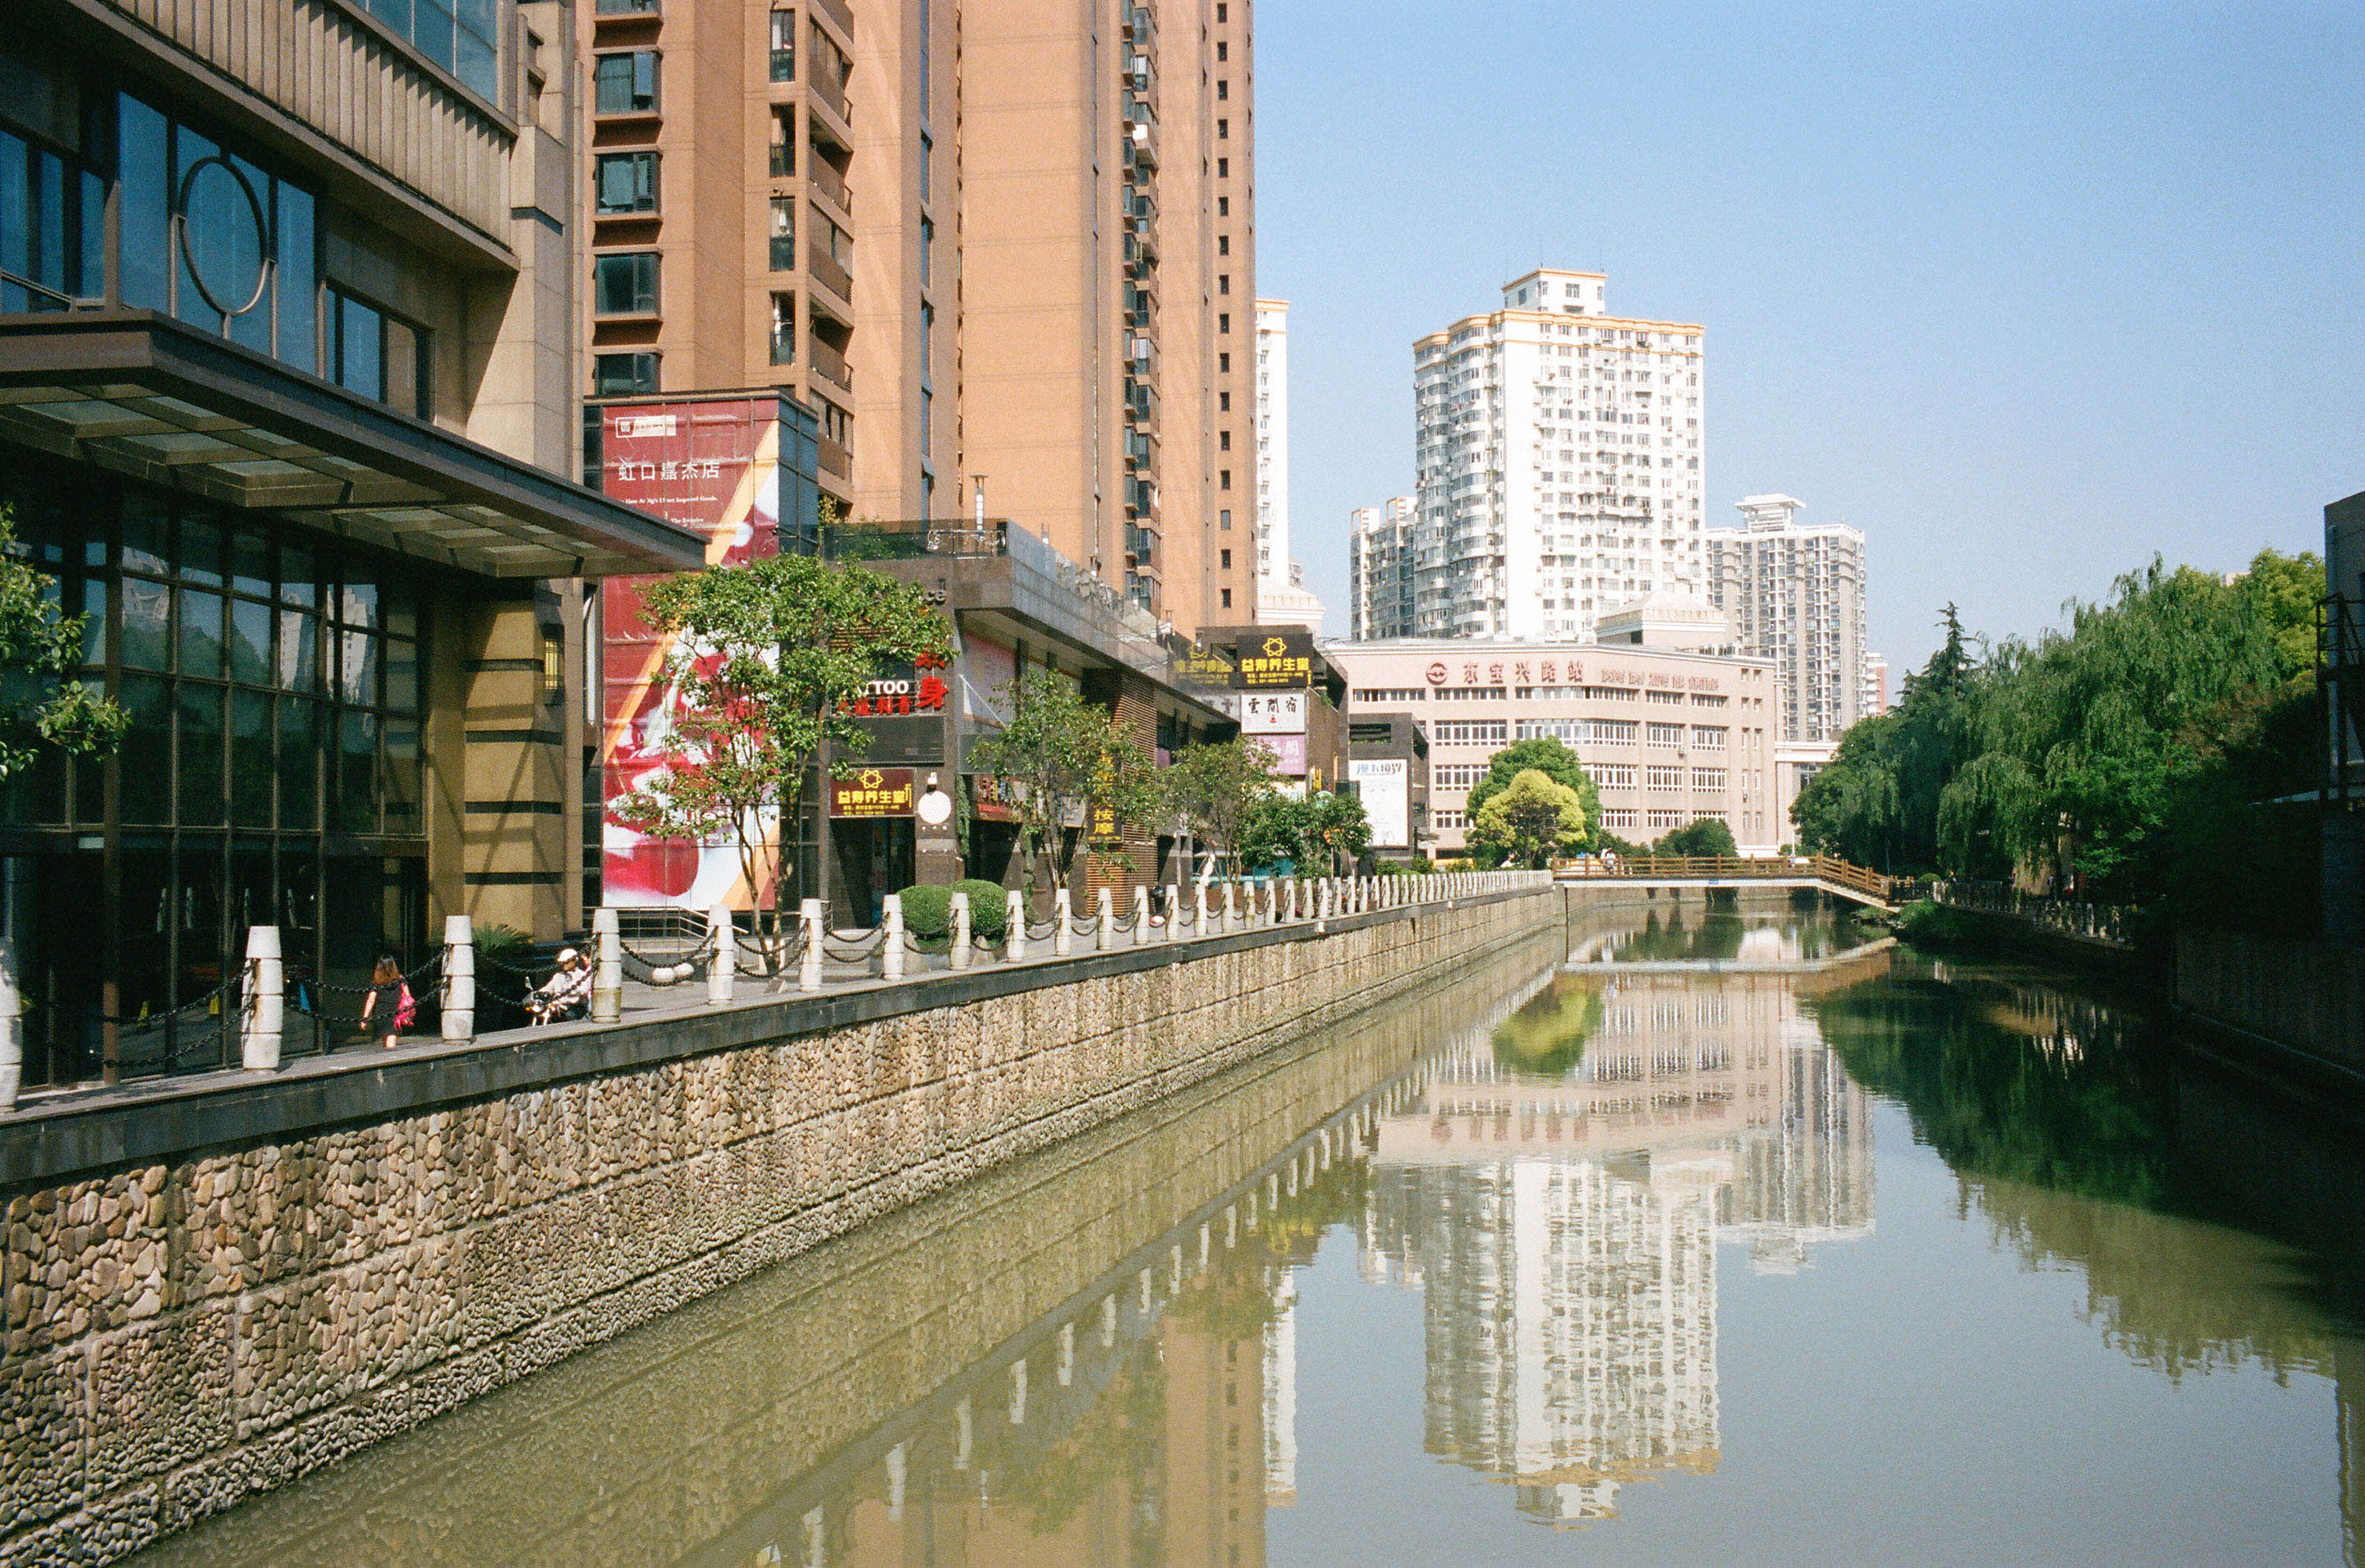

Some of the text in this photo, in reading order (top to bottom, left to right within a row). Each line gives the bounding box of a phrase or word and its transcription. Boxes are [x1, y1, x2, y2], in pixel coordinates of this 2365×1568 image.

[618, 462, 720, 481] 虹口嘉杰店
[1463, 660, 1582, 684] 东宝兴路站
